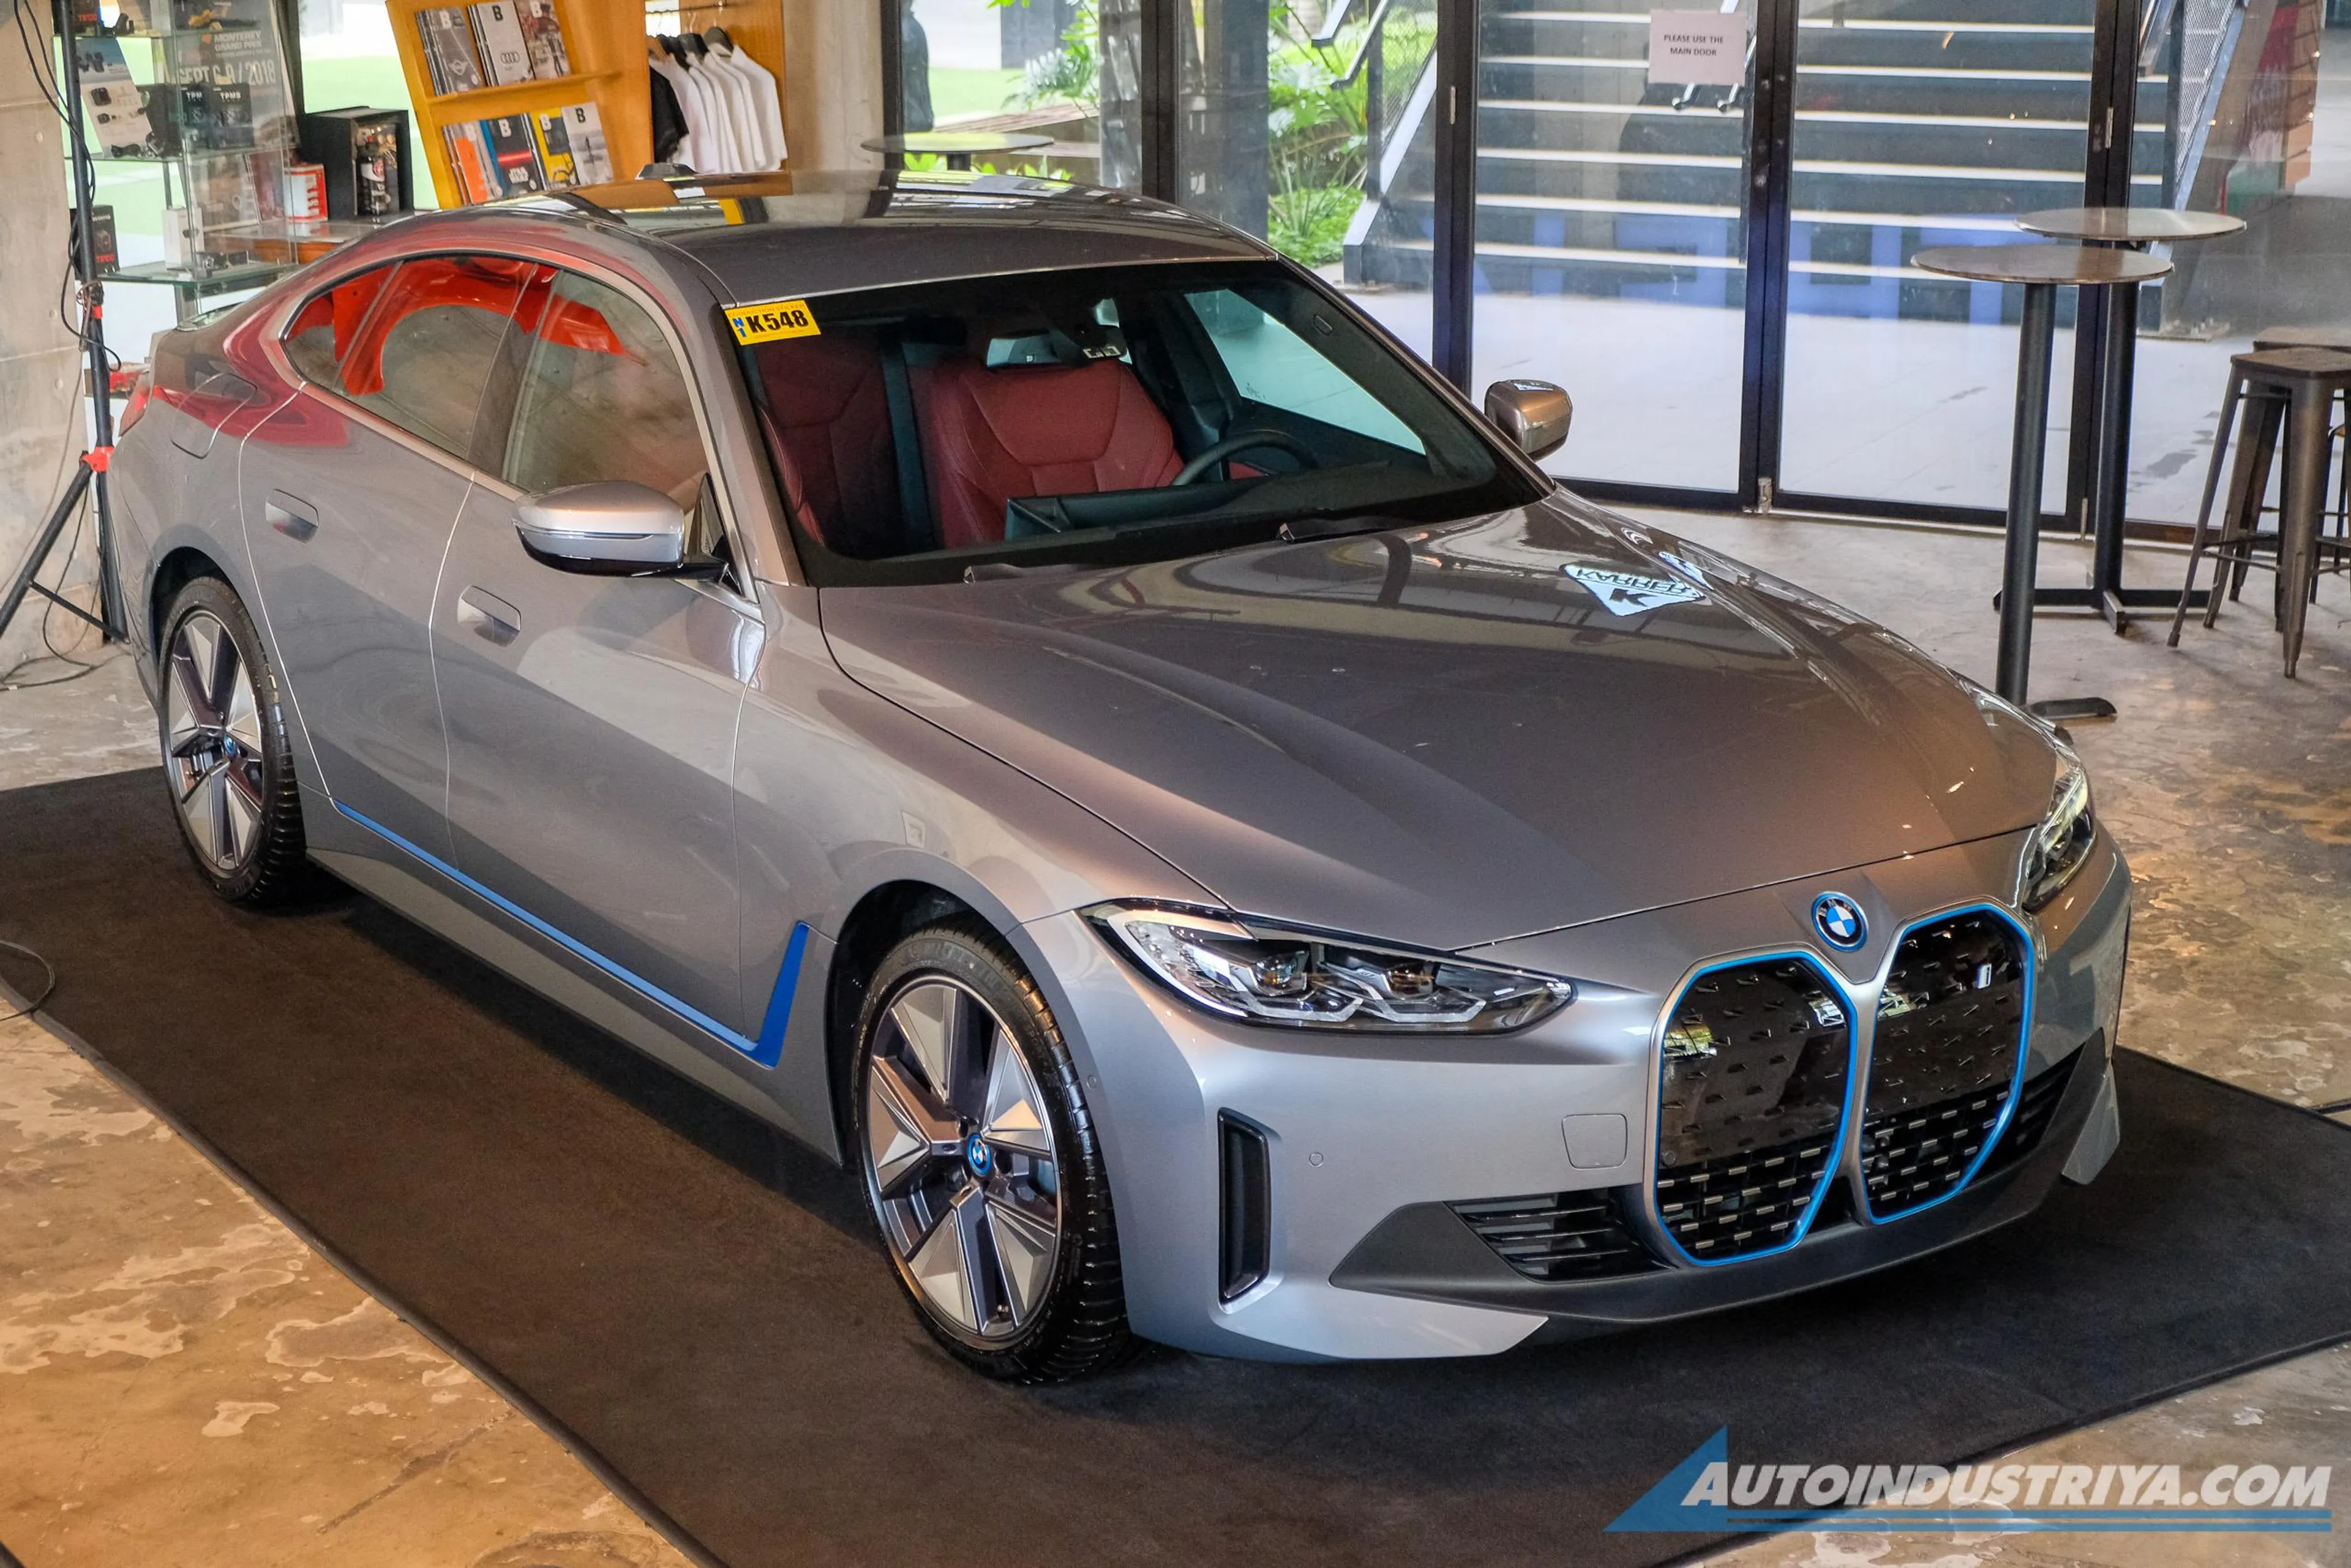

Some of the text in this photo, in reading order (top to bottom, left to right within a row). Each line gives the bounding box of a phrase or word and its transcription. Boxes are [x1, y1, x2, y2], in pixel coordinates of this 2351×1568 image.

[439, 10, 451, 29] B
[491, 6, 503, 21] B
[1663, 34, 1723, 44] PLEASE USE THE
[245, 59, 276, 86] 2018
[539, 113, 552, 131] B
[575, 108, 586, 122] B
[498, 119, 512, 138] B
[746, 310, 809, 333] K548
[1818, 899, 1852, 917] BMW
